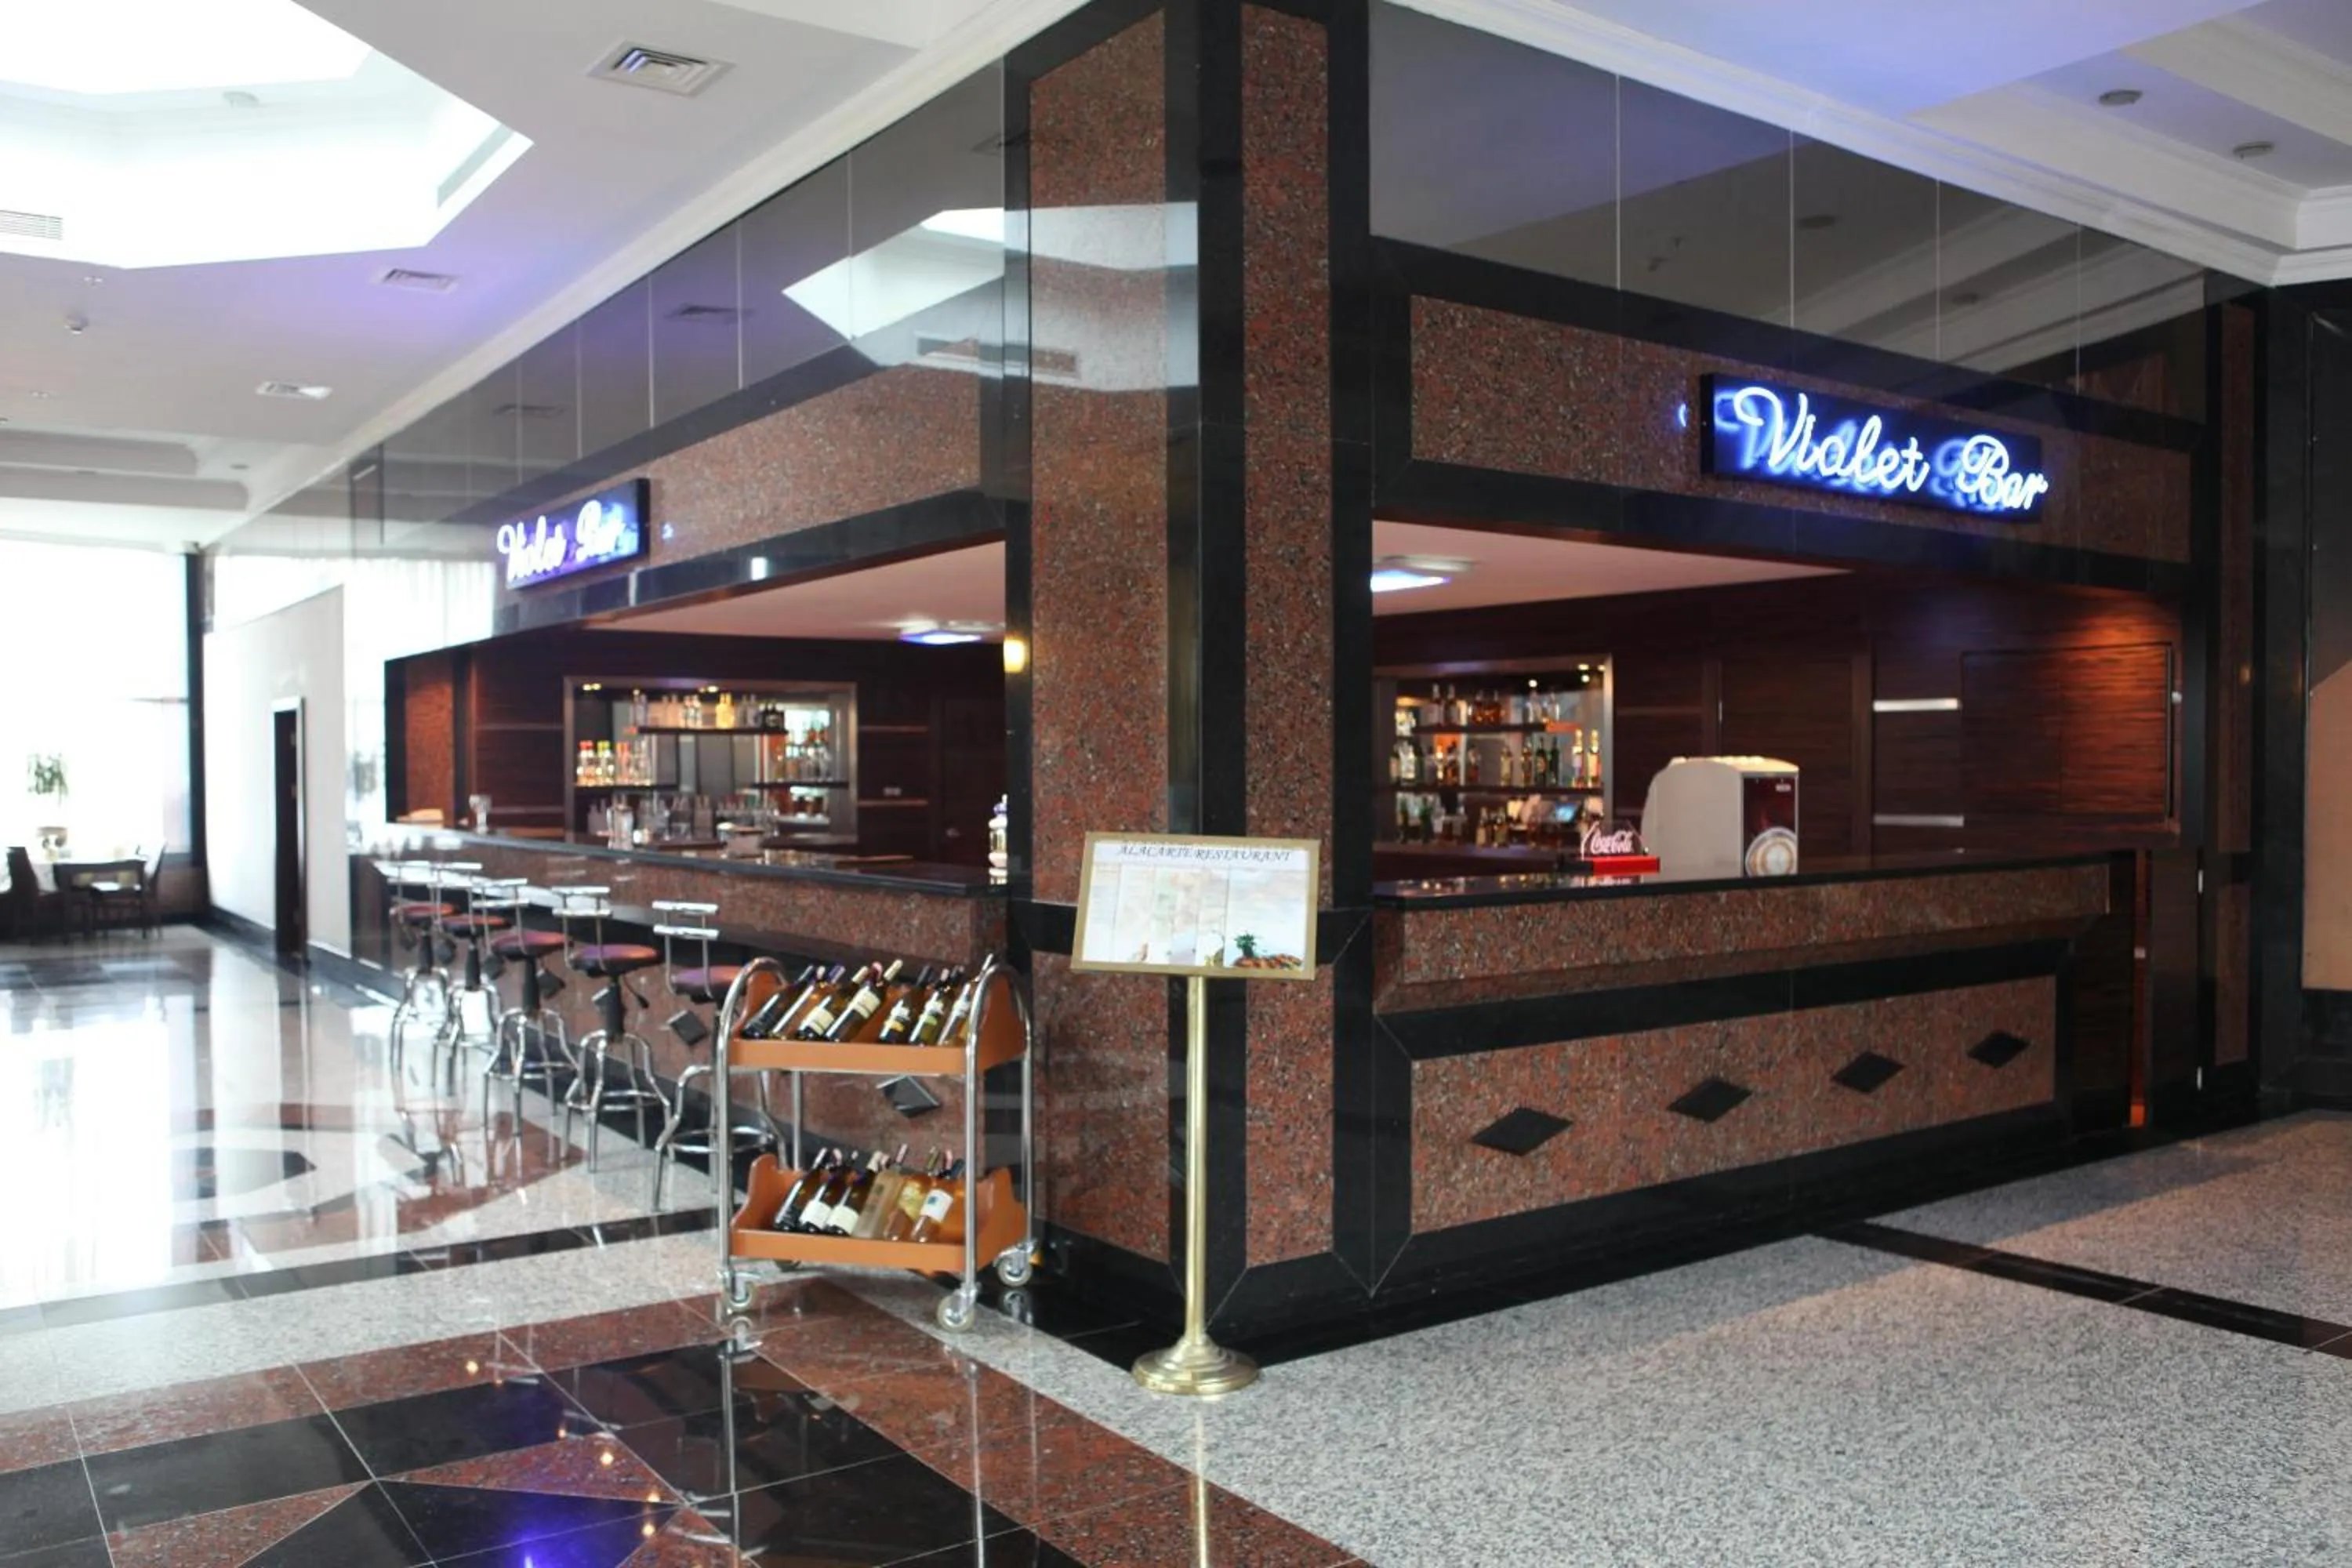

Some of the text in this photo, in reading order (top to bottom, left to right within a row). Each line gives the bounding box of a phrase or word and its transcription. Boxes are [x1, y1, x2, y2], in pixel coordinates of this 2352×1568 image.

[1733, 387, 2049, 510] Violet Bar
[1194, 848, 1290, 862] RESTAURANT
